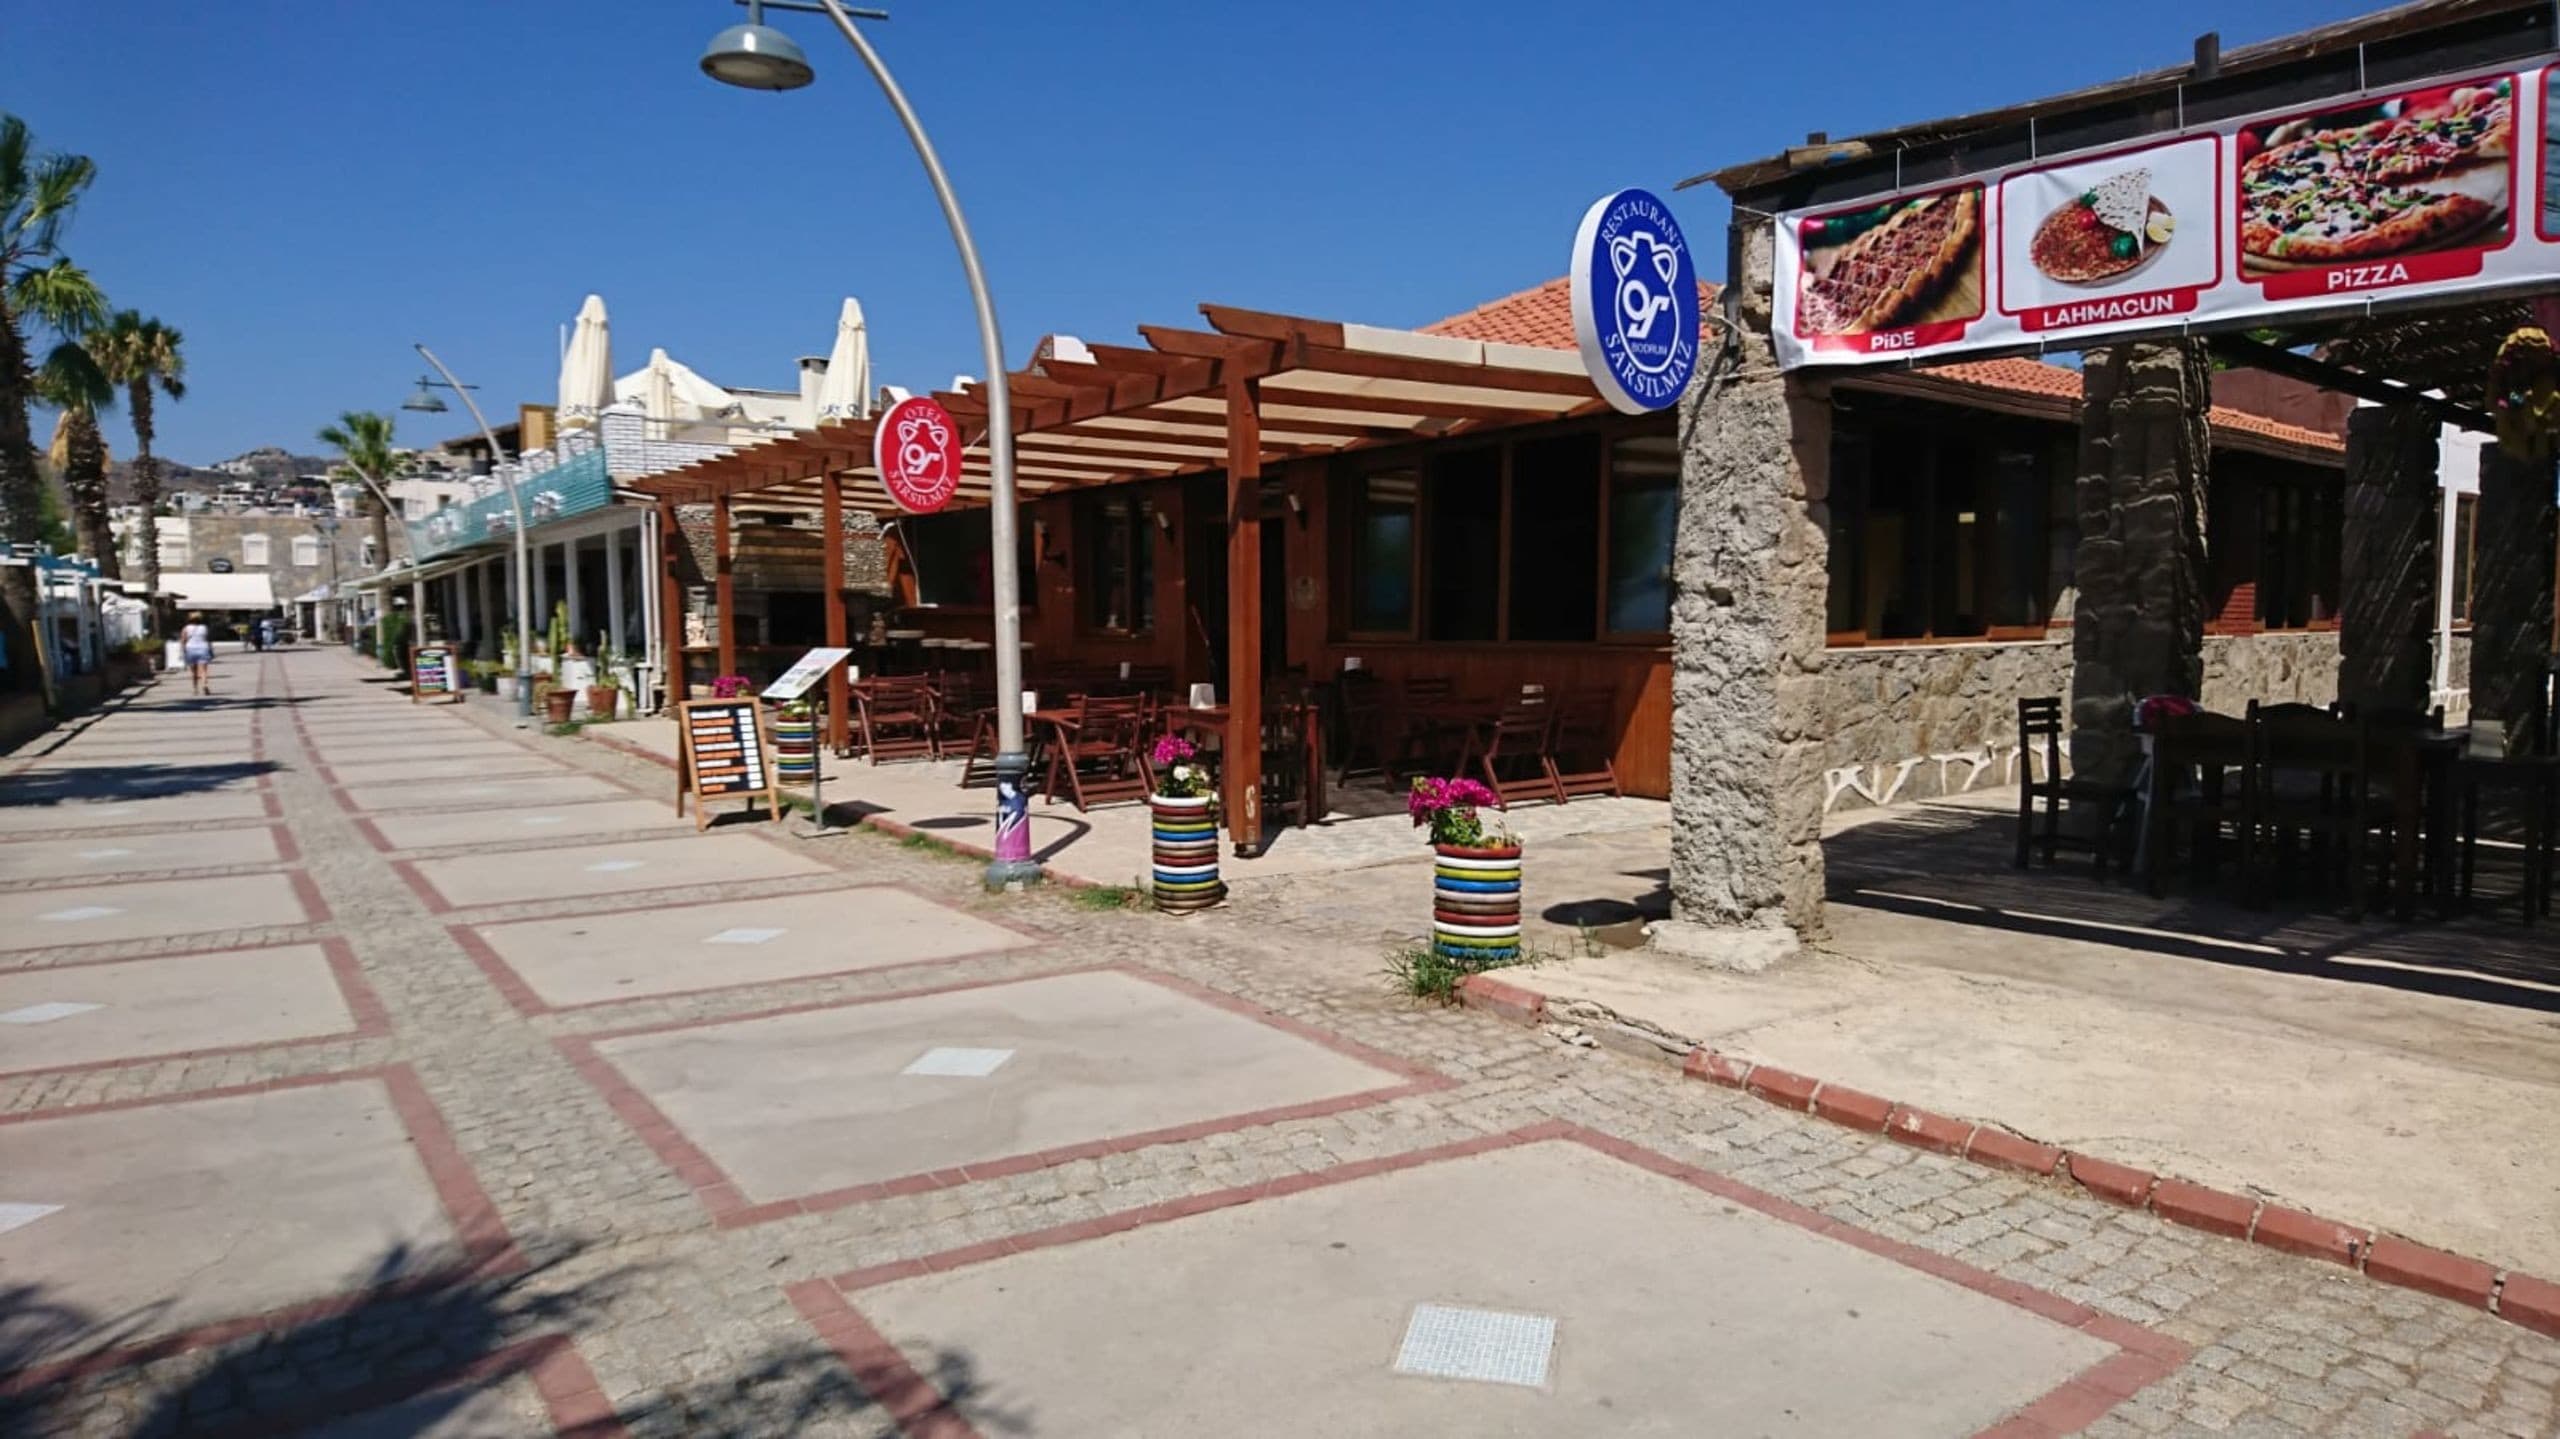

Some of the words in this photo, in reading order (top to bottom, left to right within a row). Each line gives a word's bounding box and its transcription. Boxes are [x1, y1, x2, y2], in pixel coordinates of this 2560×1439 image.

[1601, 201, 1685, 253] RESTAURANT
[2043, 294, 2173, 327] LAHMACUN
[1605, 334, 1692, 398] SARSILMAZ
[904, 406, 941, 422] OTEL
